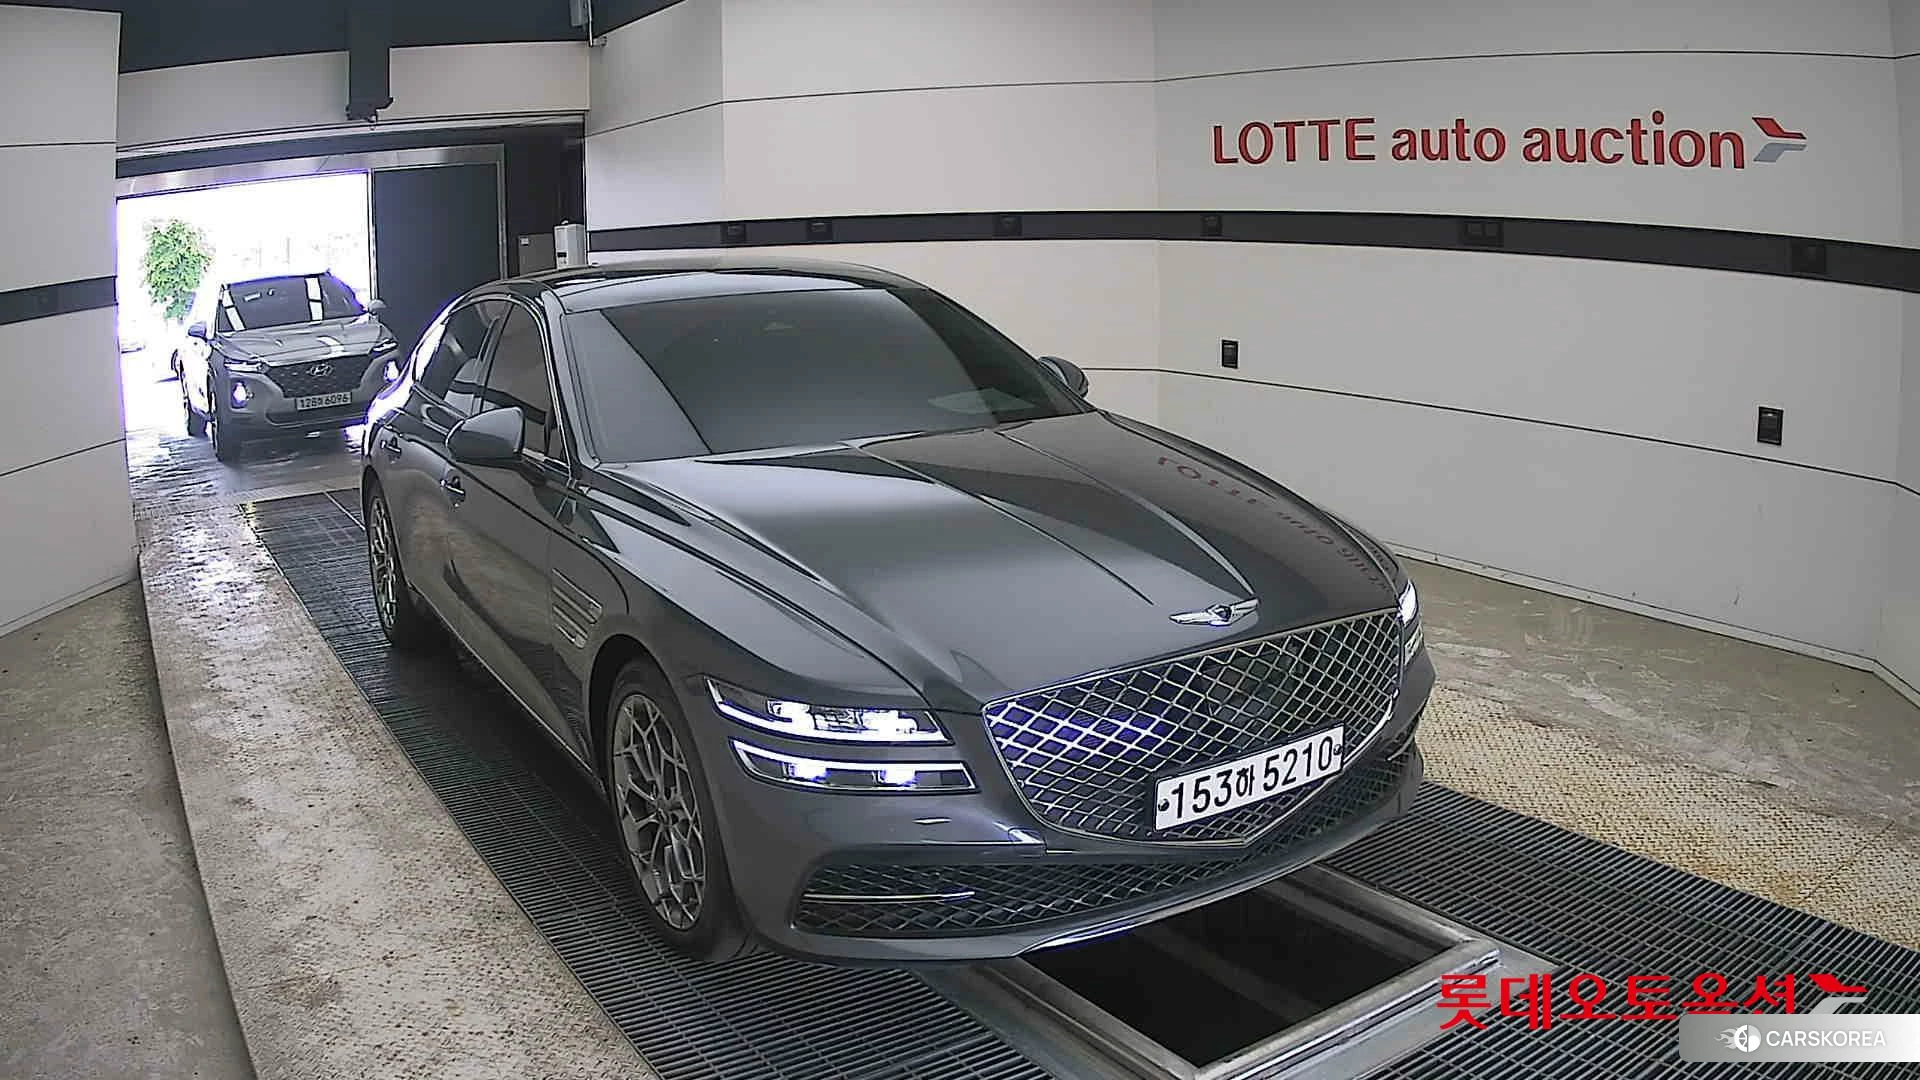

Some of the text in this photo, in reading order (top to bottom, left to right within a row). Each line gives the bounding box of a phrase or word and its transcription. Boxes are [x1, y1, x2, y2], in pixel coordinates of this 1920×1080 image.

[1213, 110, 1745, 170] LOTTE auto auction
[1171, 736, 1334, 819] 153하 5210
